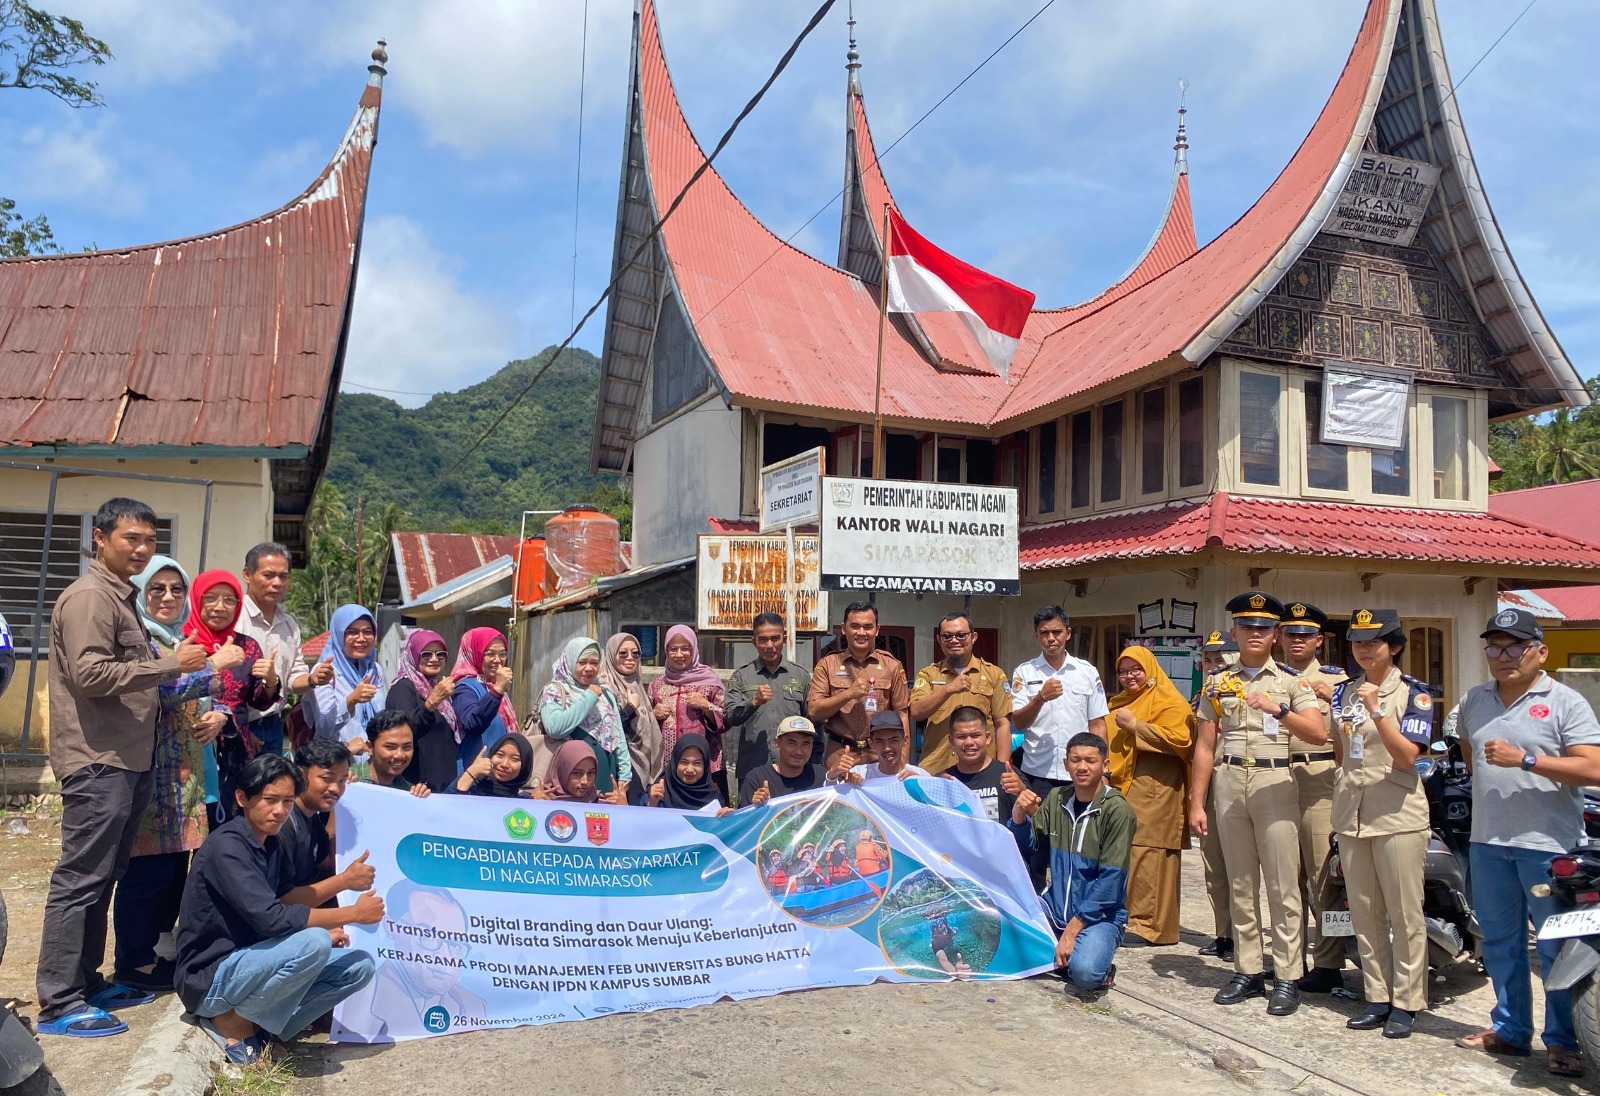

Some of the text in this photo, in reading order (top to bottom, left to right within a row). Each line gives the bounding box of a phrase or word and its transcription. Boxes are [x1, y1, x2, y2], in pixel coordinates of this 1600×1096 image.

[1361, 158, 1419, 179] BALAI
[1343, 169, 1382, 197] ERAPATAN
[1337, 206, 1412, 230] NAGARI SIMARASOK
[1340, 220, 1399, 239] KECAMATAN BASO
[770, 490, 813, 512] SEKRETARIAT
[863, 486, 1006, 513] PEMERINTAH KABUPATEN AGAM
[837, 516, 1005, 537] KANTOR WALI NAGARI
[729, 540, 766, 551] PEMERINTAH
[864, 543, 977, 565] SIMARASOK
[839, 576, 996, 592] KECAMATAN BASO
[719, 600, 753, 614] NAGARI
[422, 841, 701, 871] PENGABDIAN KEPADA MASYARAKAT
[480, 866, 654, 888] DI NAGARI SIMARASOK
[386, 920, 797, 948] Transformasi Wisata Simarasok Menuju Keberlanjutan
[470, 915, 713, 936] Digital Branding dan Daur Ulang:
[377, 947, 811, 977] KERJASAMA PRODI MANAJEMEN FEB UNIVERSITAS BUNG HATTA
[492, 973, 712, 992] DENGAN IPDN KAMPUS SUMBAR
[453, 1013, 566, 1027] 26 November 2024
